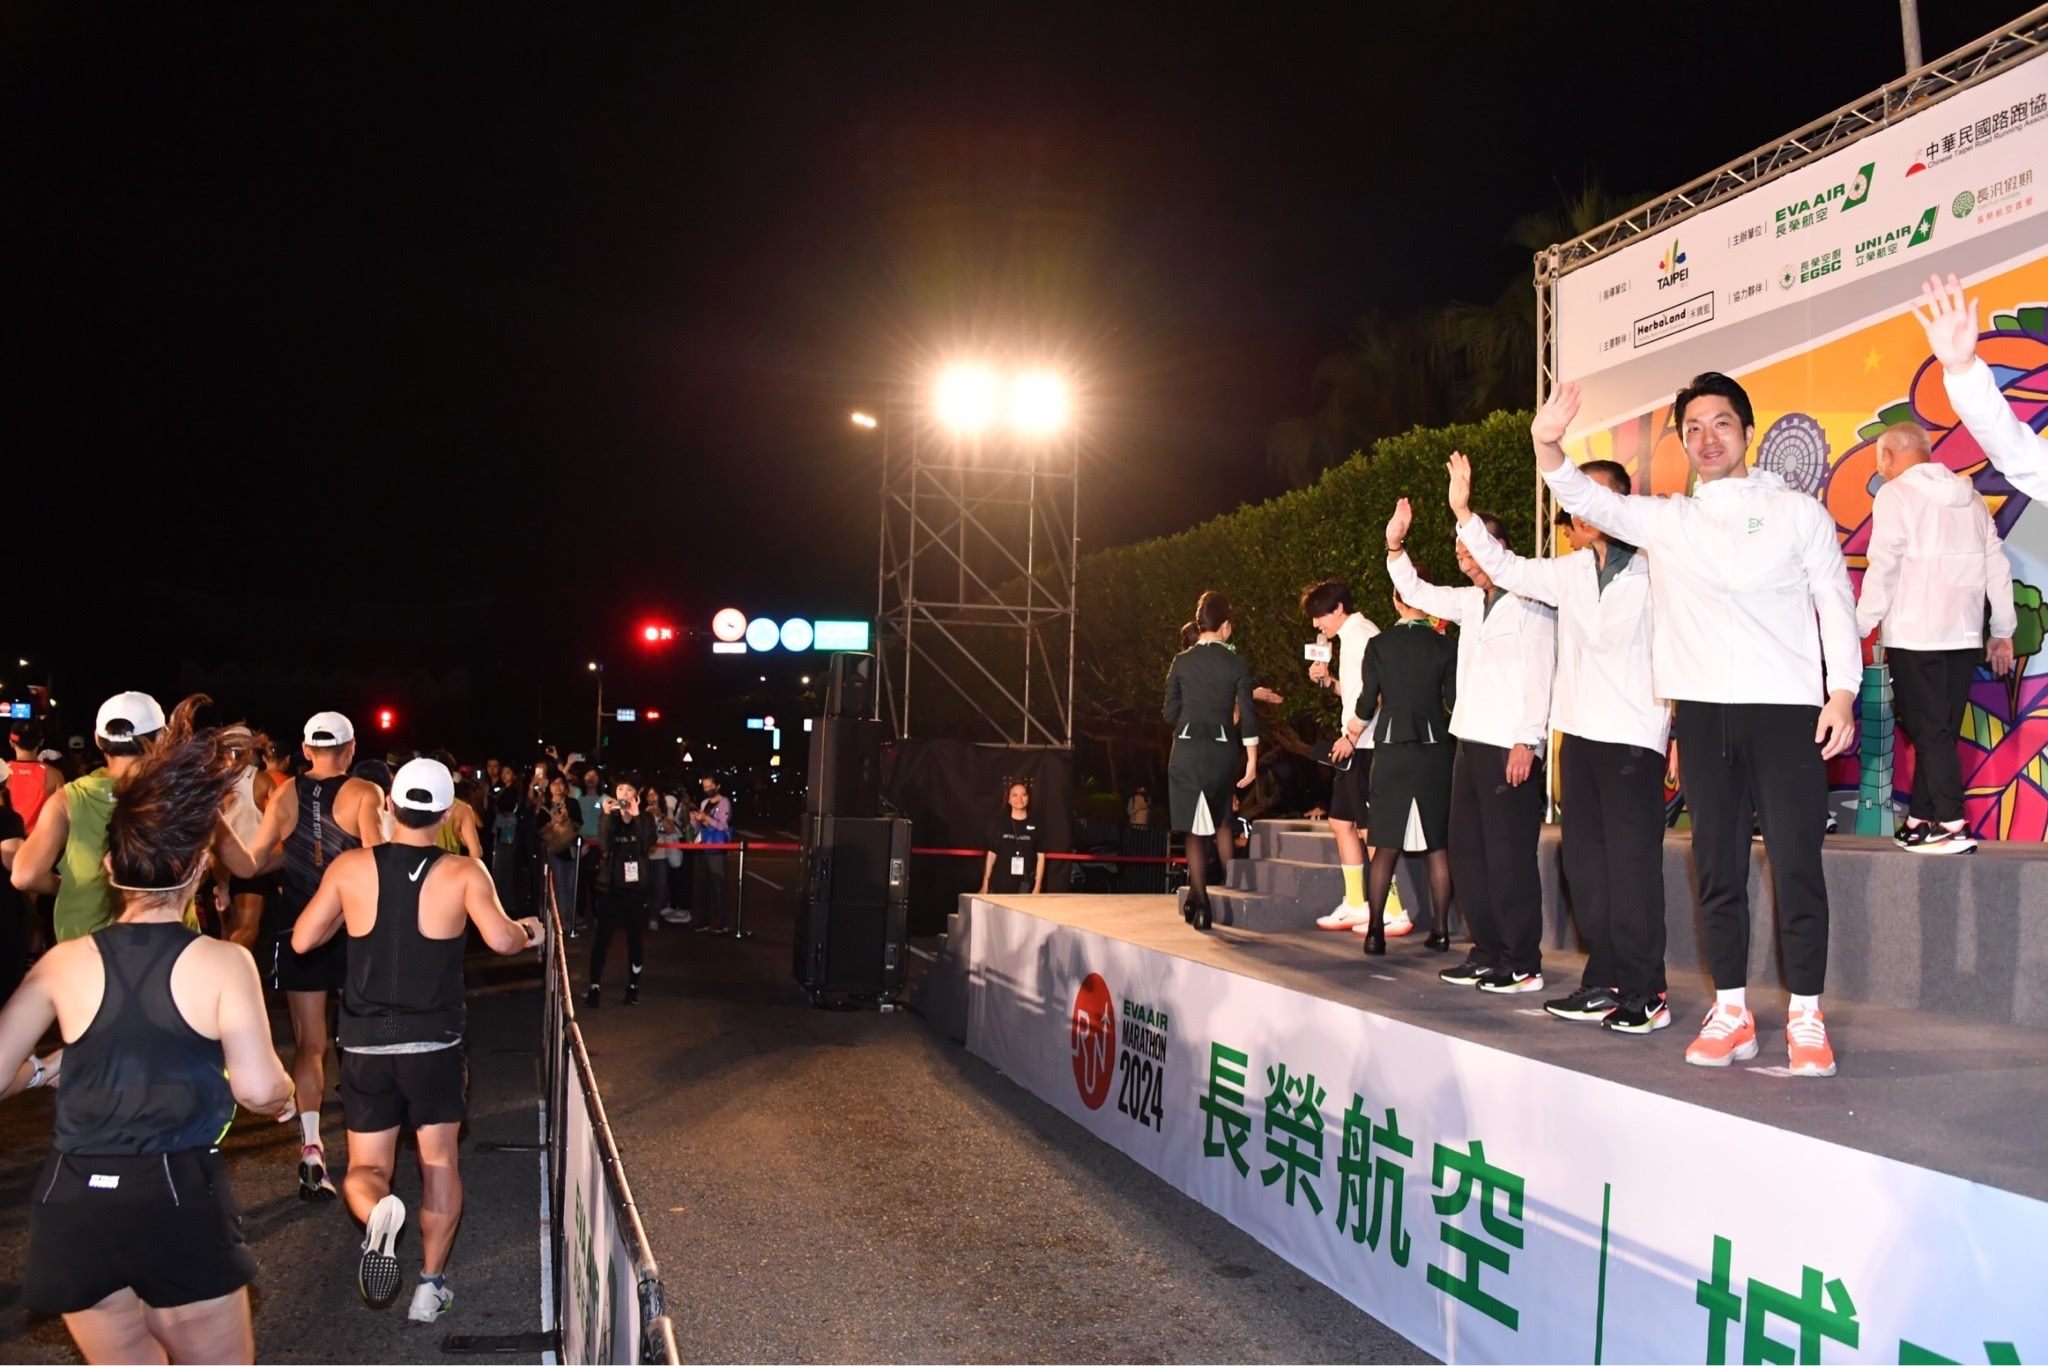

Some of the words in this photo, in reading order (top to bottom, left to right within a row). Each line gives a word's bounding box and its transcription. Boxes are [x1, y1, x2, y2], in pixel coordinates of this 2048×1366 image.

[1926, 93, 2047, 160] 中華民國路跑協
[1928, 154, 1953, 169] Chinese
[1954, 145, 1974, 159] Taipei
[1975, 136, 1993, 148] Road
[1994, 124, 2023, 140] Running
[1775, 200, 1811, 223] EVA
[1813, 183, 1845, 209] AIR
[1732, 225, 1762, 247] 主辦單位
[1775, 207, 1828, 239] 長榮航空
[1855, 235, 1882, 254] UNI
[1884, 224, 1912, 243] AIR
[1855, 243, 1898, 267] 立榮航空
[1657, 267, 1689, 290] TAIPEI
[1800, 260, 1842, 284] EGSC
[1637, 308, 1686, 336] HerbaLand
[1123, 999, 1146, 1023] EVA
[1146, 1008, 1169, 1031] AIR
[1121, 1020, 1168, 1064] MARATHON
[1118, 1050, 1164, 1134] 2024
[1199, 1040, 1526, 1333] 長榮航空
